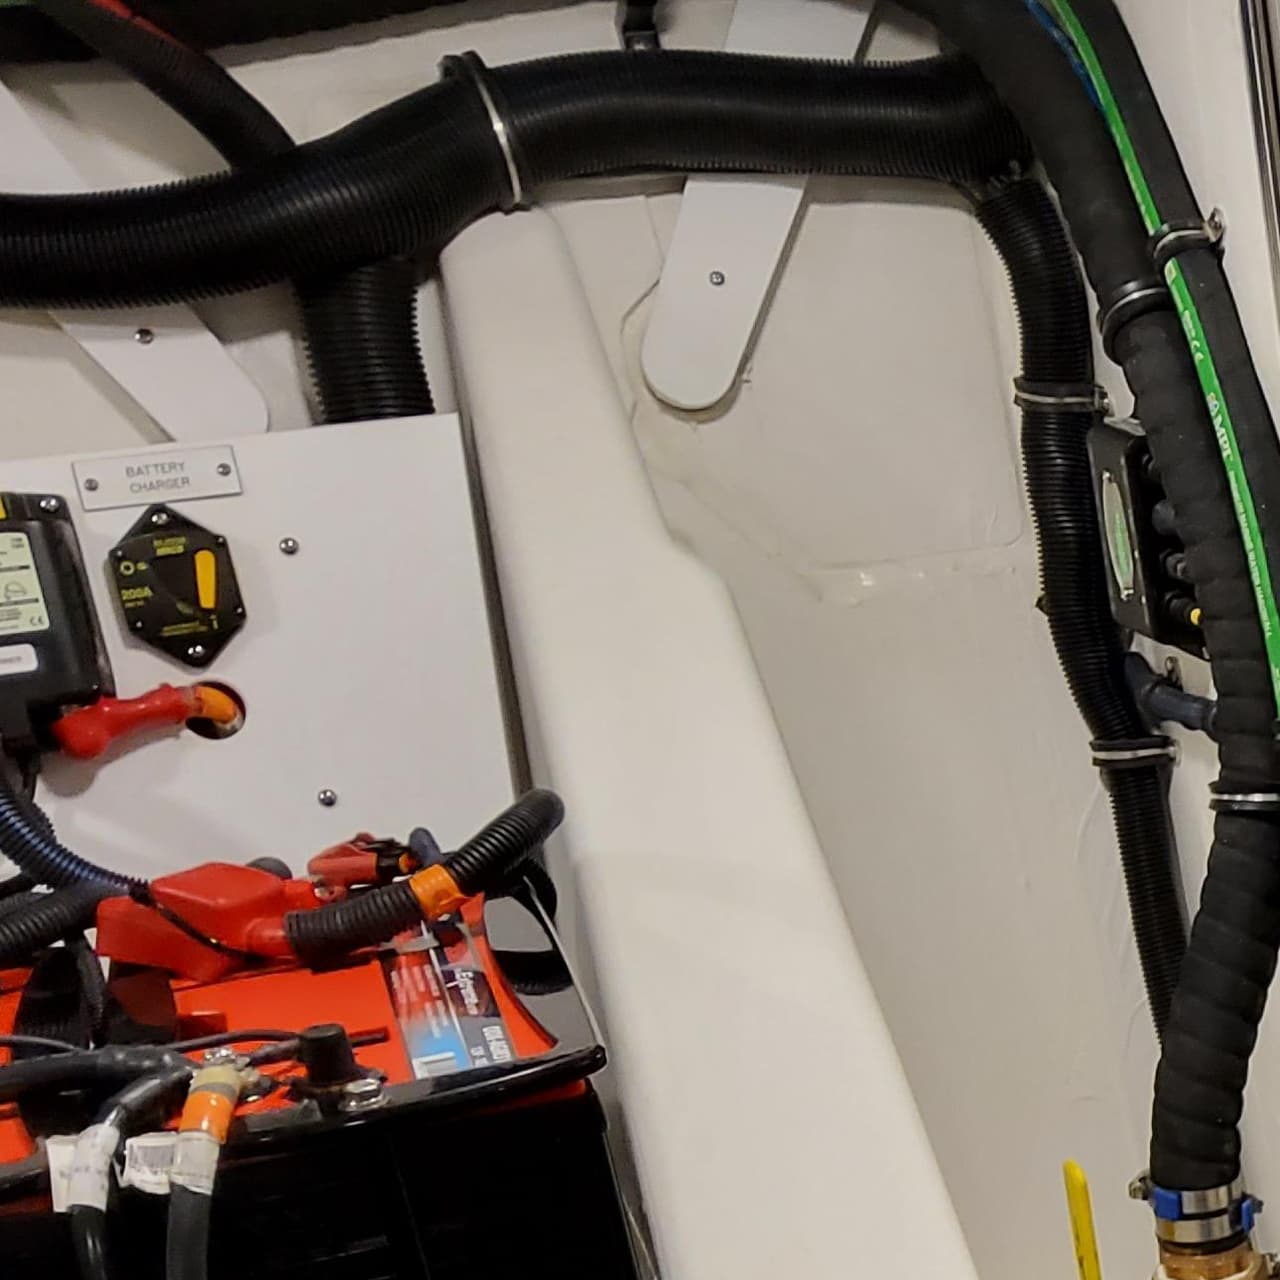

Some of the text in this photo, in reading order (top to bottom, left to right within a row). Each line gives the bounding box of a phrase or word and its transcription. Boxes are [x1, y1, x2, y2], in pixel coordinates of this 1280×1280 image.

[126, 461, 186, 478] BATTERY
[129, 476, 190, 494] CHARGER
[1247, 550, 1261, 586] WATER
